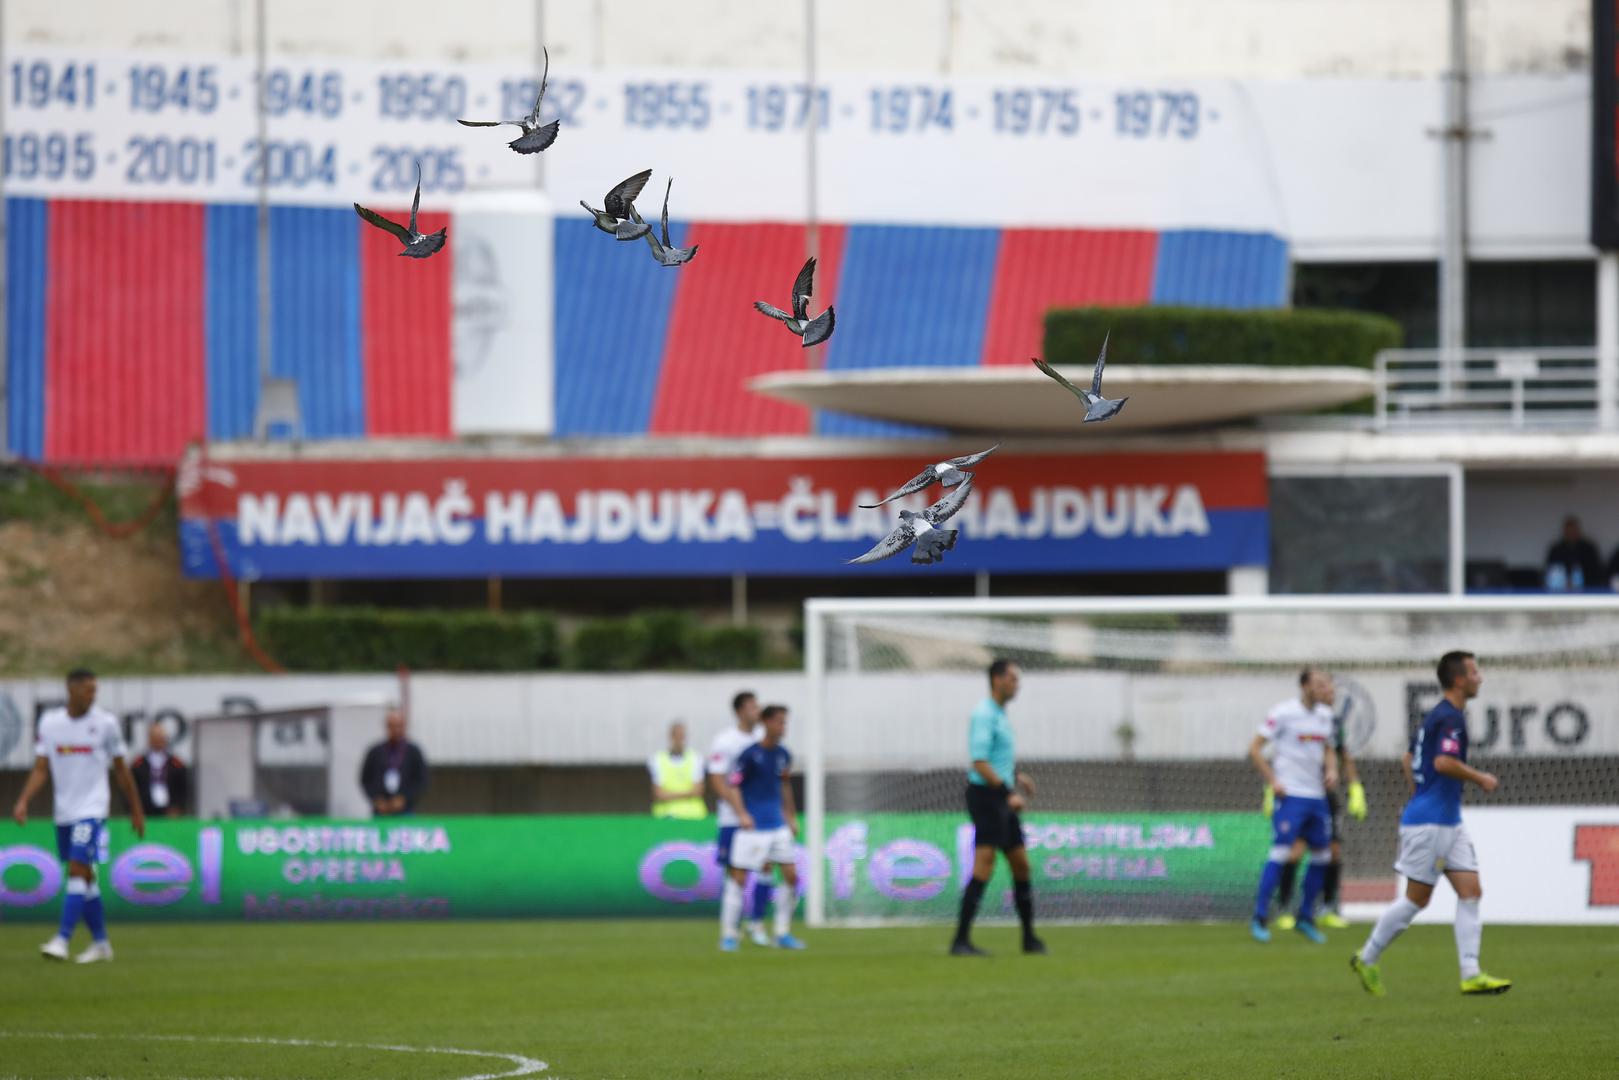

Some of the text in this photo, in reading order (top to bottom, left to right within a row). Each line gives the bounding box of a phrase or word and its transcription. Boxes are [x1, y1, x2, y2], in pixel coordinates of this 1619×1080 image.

[11, 60, 97, 109] 1941
[128, 63, 219, 114] 1945
[377, 73, 466, 119] 1950
[624, 80, 710, 129] 1955
[746, 84, 831, 132] 1971
[869, 86, 954, 134] 1974
[993, 87, 1081, 136] 1975
[1115, 90, 1201, 138] 1979
[2, 132, 466, 191] 1995 2001 2004 2005
[237, 478, 475, 545] NAVIJAČ
[945, 483, 1209, 539] HAJDUKA
[238, 826, 450, 854] UGOSTITELJSKA
[283, 858, 405, 883] OPREMA
